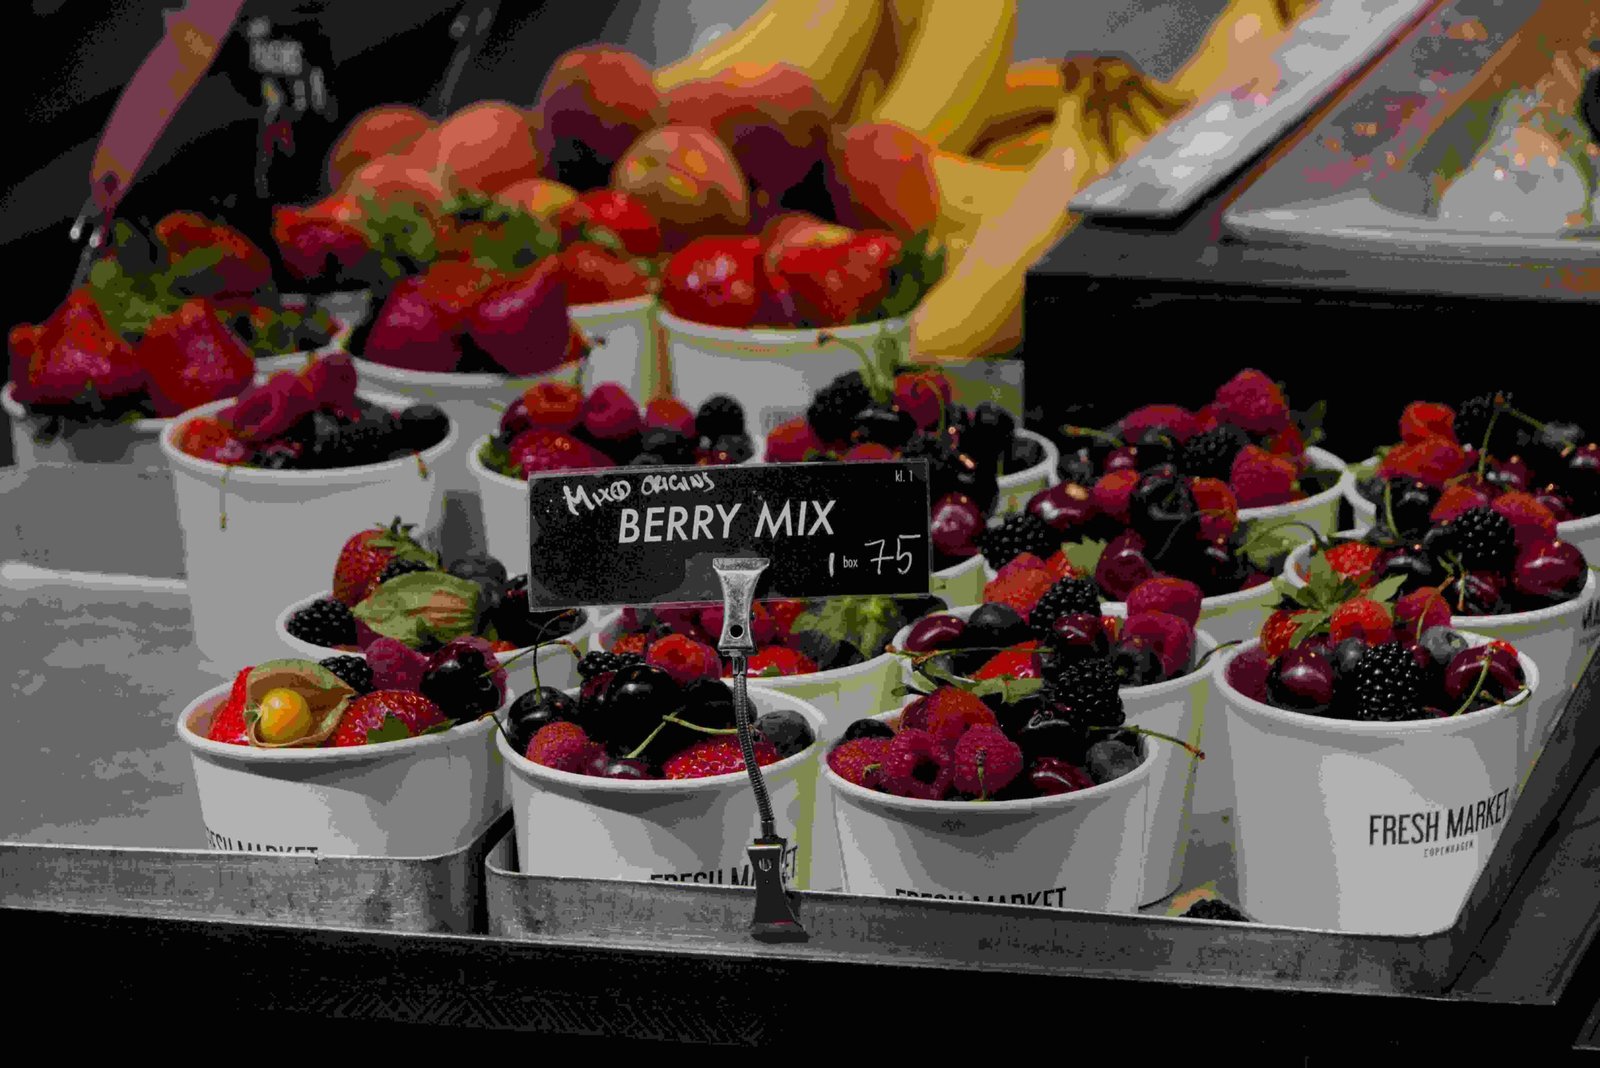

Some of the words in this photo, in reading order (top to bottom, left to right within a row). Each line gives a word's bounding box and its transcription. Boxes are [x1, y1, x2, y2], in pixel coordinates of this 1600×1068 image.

[641, 472, 715, 496] ORIGINS
[618, 503, 742, 544] BERRY
[753, 499, 837, 538] MIX
[843, 555, 858, 569] box
[864, 534, 921, 575] 75
[1369, 811, 1440, 846] FRESH
[1446, 787, 1510, 840] MARKET
[1423, 840, 1475, 858] COPENHAGEN
